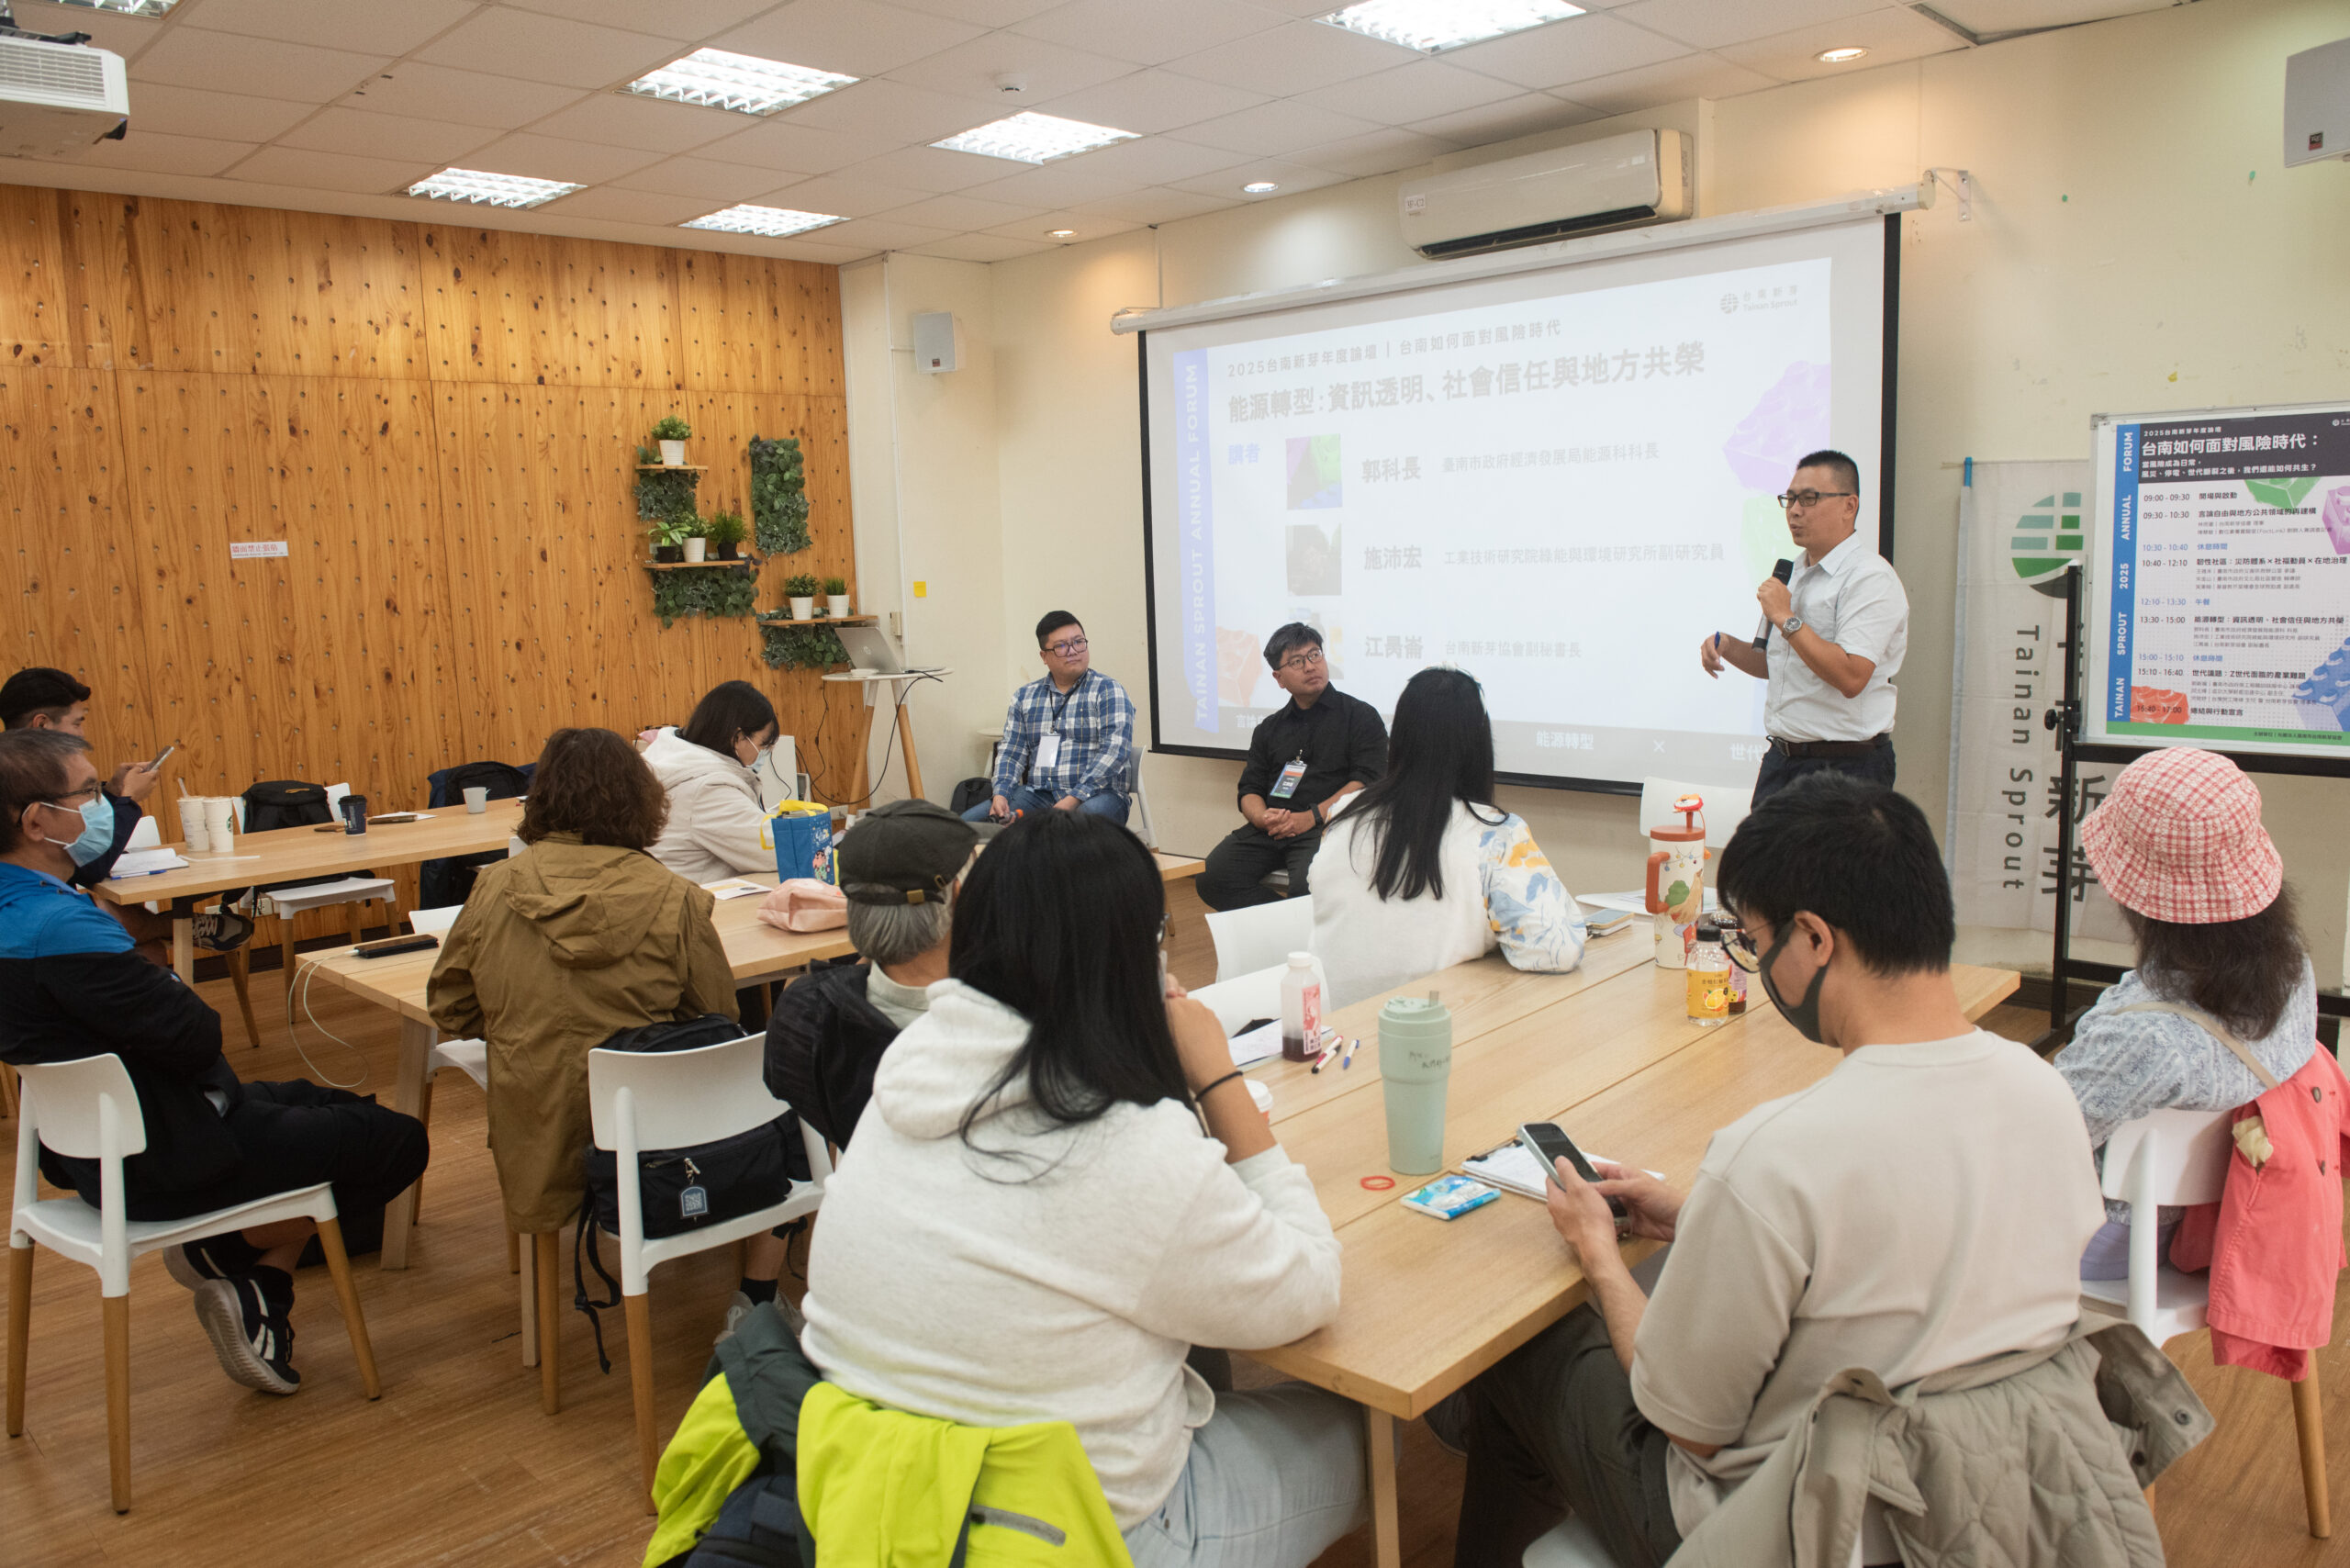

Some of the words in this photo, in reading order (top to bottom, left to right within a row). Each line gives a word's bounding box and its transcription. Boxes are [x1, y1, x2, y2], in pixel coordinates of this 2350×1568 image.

[1771, 298, 1799, 310] Sprout
[1400, 319, 1562, 355] 台南如何面對風險時代
[1188, 364, 1198, 442] FORUM
[1361, 456, 1422, 484] 郭科長
[2123, 431, 2132, 473] FORUM
[1190, 451, 1202, 541] ANNUAL
[2121, 494, 2131, 540] ANNUAL
[2119, 563, 2129, 589] 2025
[2142, 559, 2161, 567] 10:40
[1192, 548, 1204, 633] SPROUT
[2141, 598, 2160, 606] 12:10
[2167, 598, 2187, 606] 13:30
[2117, 612, 2127, 655] SPROUT
[2164, 668, 2184, 677] 16:40
[2165, 654, 2184, 662] 15:10
[1195, 644, 1209, 721] TAINAN
[2011, 624, 2040, 745] Tainan
[2114, 677, 2124, 718] TAINAN
[2001, 767, 2033, 890] Sprout
